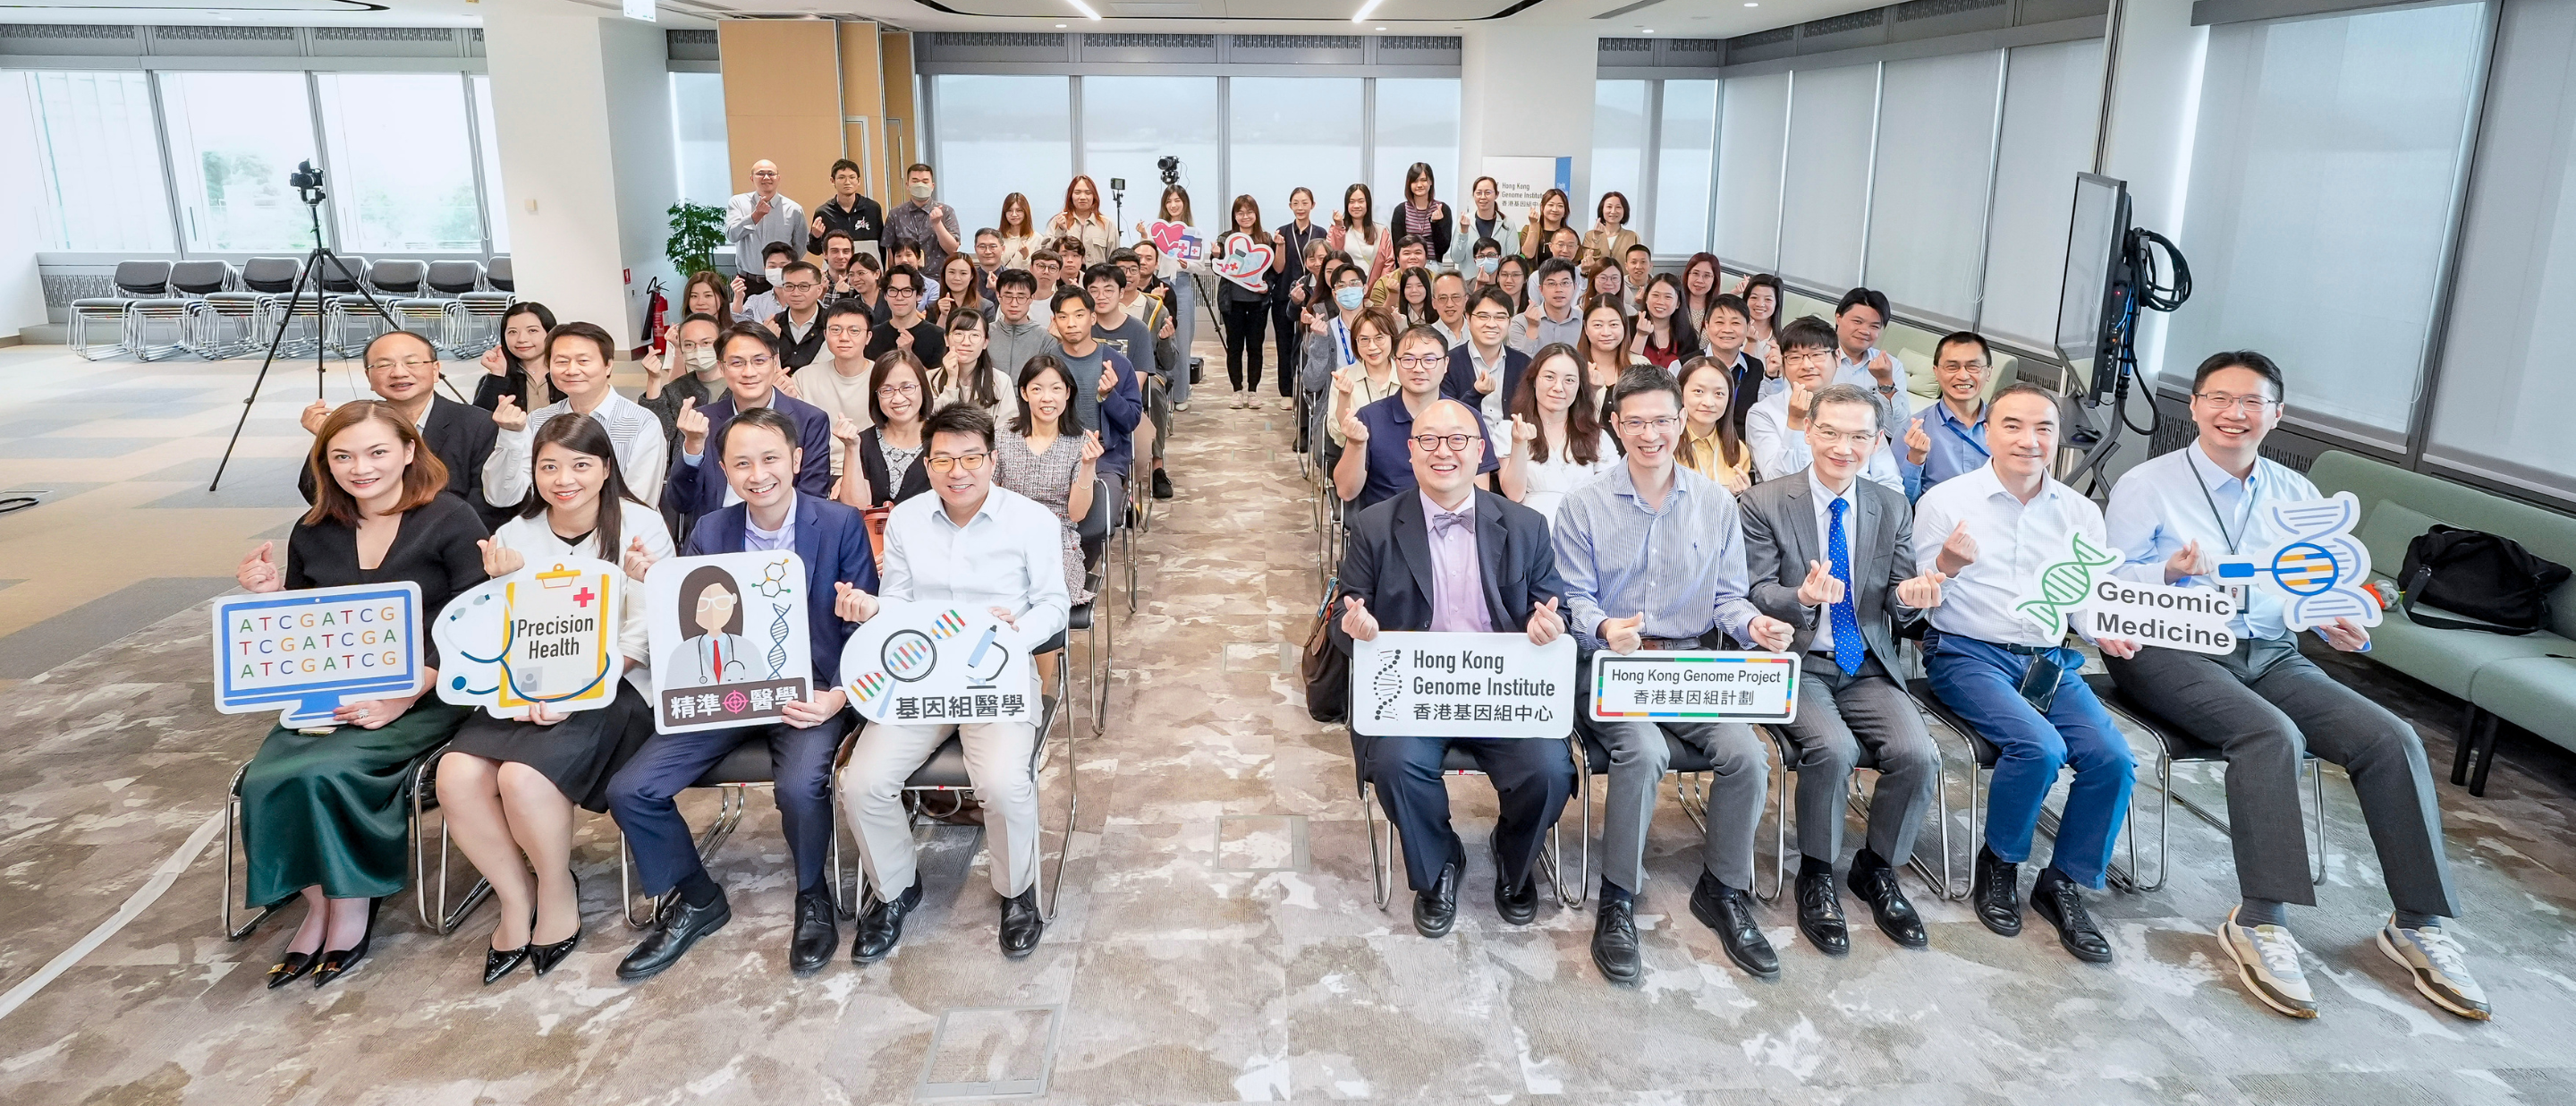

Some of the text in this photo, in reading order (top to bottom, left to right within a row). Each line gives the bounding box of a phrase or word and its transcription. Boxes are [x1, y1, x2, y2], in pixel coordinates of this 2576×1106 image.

[1502, 183, 1530, 191] Hong Kong
[2097, 581, 2230, 616] Genomic
[518, 615, 594, 638] Precision
[2097, 611, 2230, 648] Medicine
[529, 637, 580, 659] Health
[1413, 650, 1504, 674] Hong Kong
[1413, 676, 1555, 696] Genome Institute
[1612, 668, 1781, 685] Hong Kong Genome Project
[670, 693, 722, 719] 精準
[895, 693, 1025, 719] 基因組醫學
[1633, 689, 1754, 706] 香港基因組計劃
[1413, 702, 1554, 722] 香港基因組中心
